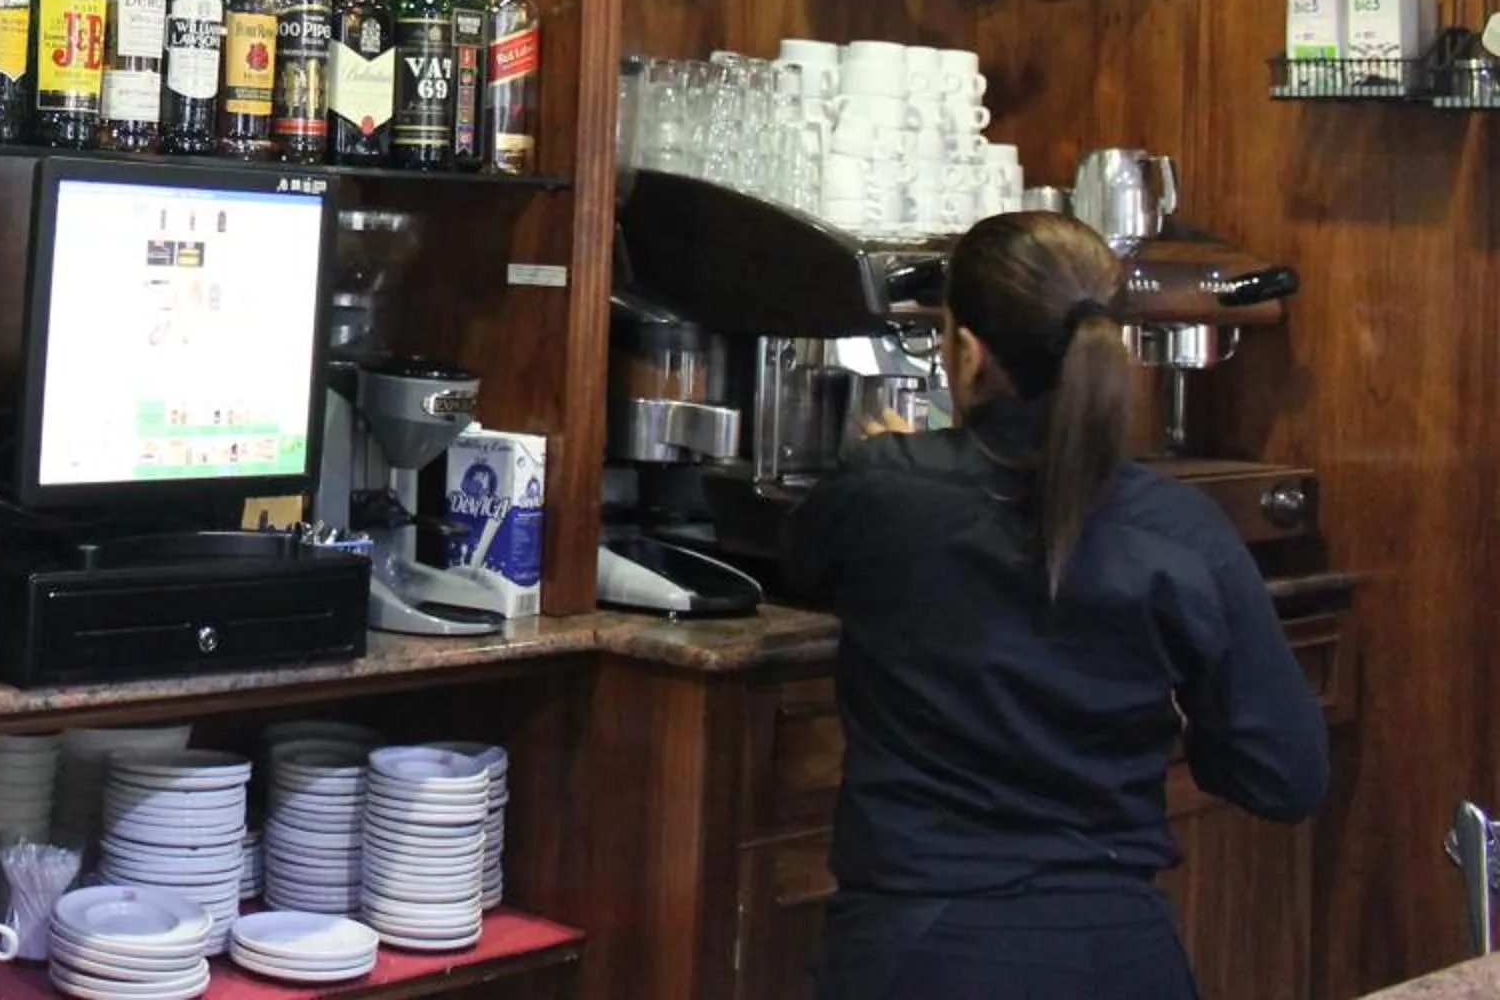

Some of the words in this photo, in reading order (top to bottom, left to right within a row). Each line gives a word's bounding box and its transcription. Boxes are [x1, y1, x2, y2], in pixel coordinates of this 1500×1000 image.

[276, 21, 301, 37] 00
[304, 20, 332, 39] PIPE
[405, 57, 453, 80] VAT
[417, 79, 449, 99] 69
